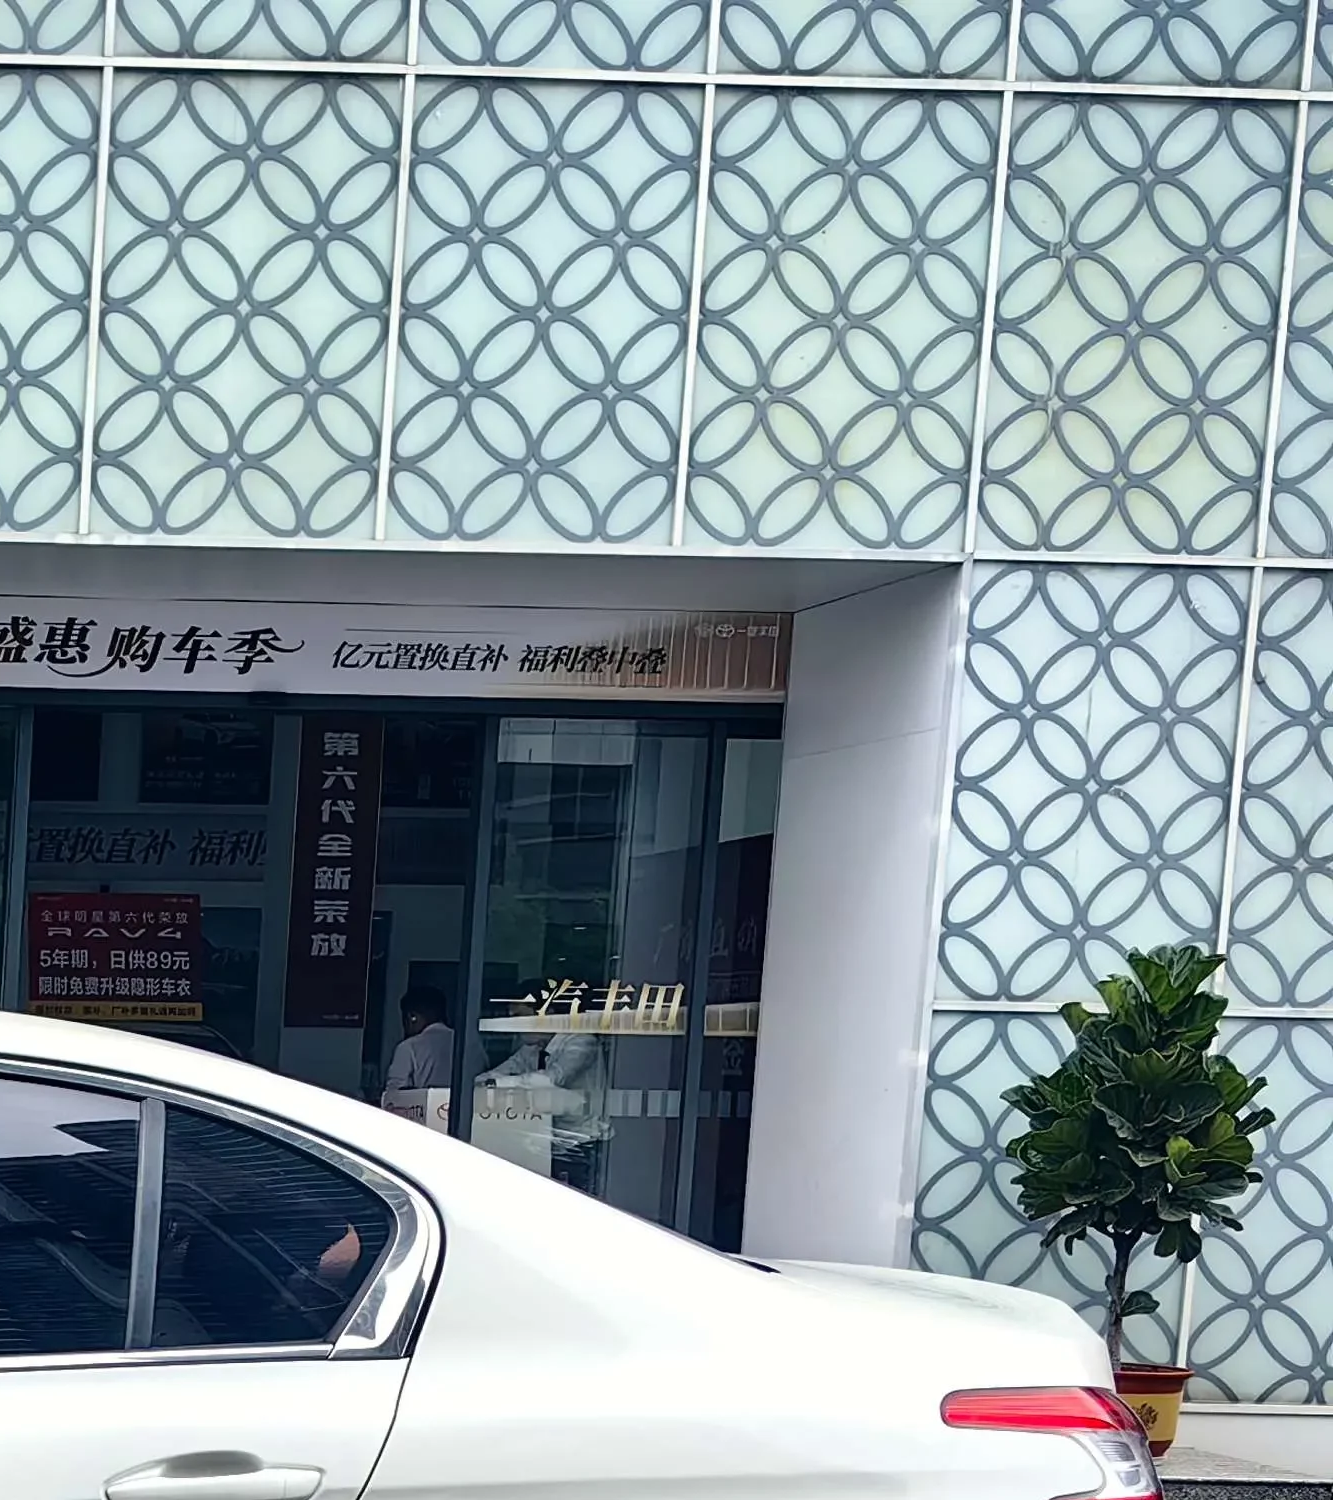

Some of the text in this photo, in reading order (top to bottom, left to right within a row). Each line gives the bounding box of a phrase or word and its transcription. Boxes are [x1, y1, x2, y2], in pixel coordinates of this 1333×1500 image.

[309, 731, 361, 957] 第六代全新荣放
[38, 976, 192, 997] 限时免费升级隐形车衣
[488, 978, 686, 1030] 一汽丰田
